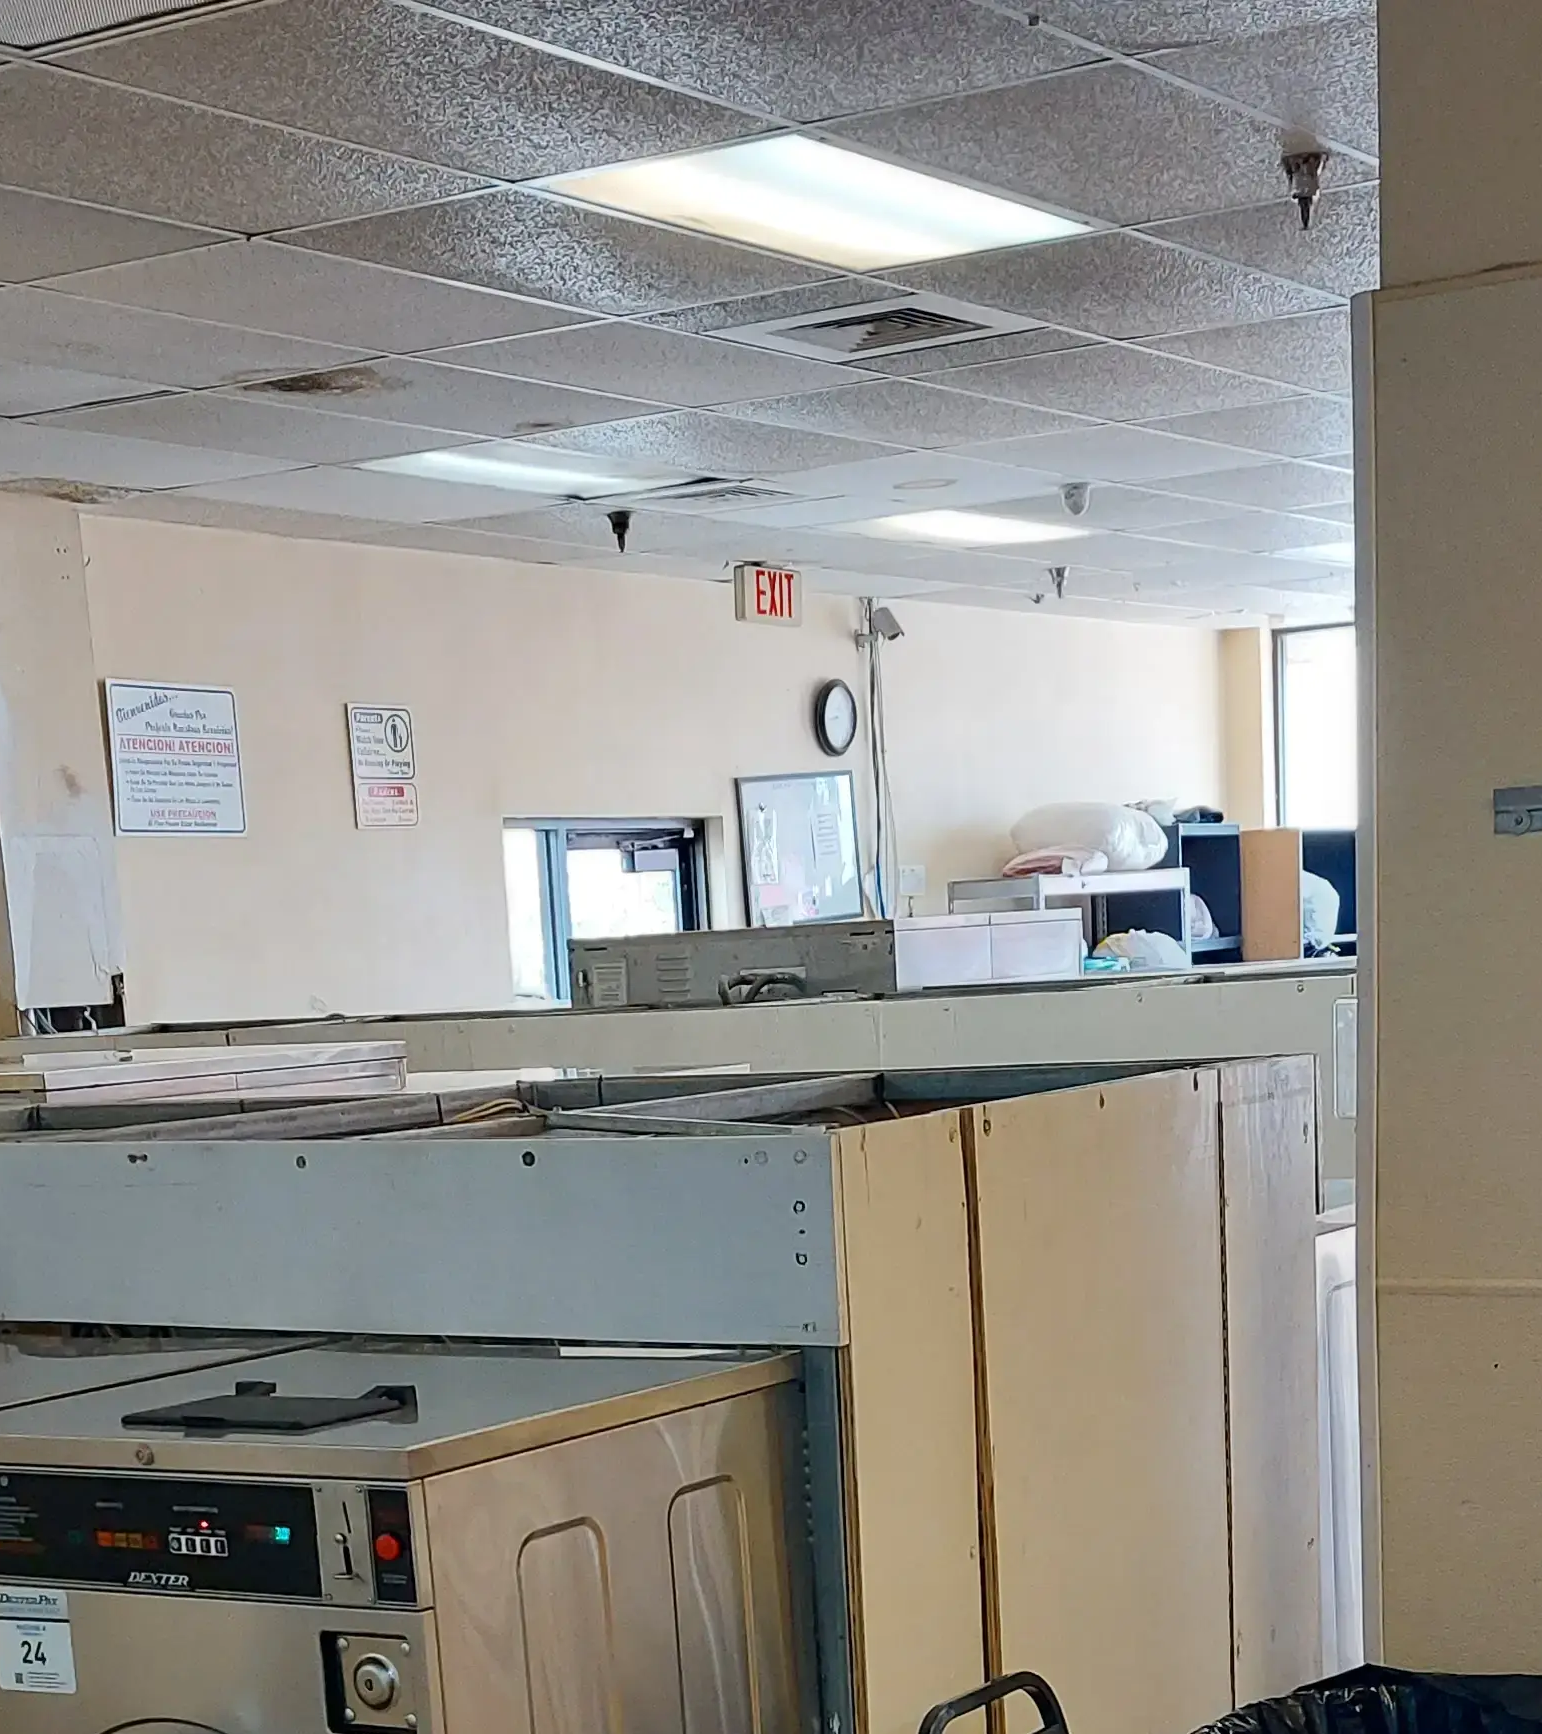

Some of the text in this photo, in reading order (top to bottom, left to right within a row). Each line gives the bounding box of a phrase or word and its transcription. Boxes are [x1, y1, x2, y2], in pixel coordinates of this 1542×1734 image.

[755, 569, 794, 618] EXIT
[179, 740, 234, 754] ATENCION!
[128, 1571, 189, 1586] DEXTER
[21, 1641, 47, 1666] 24
